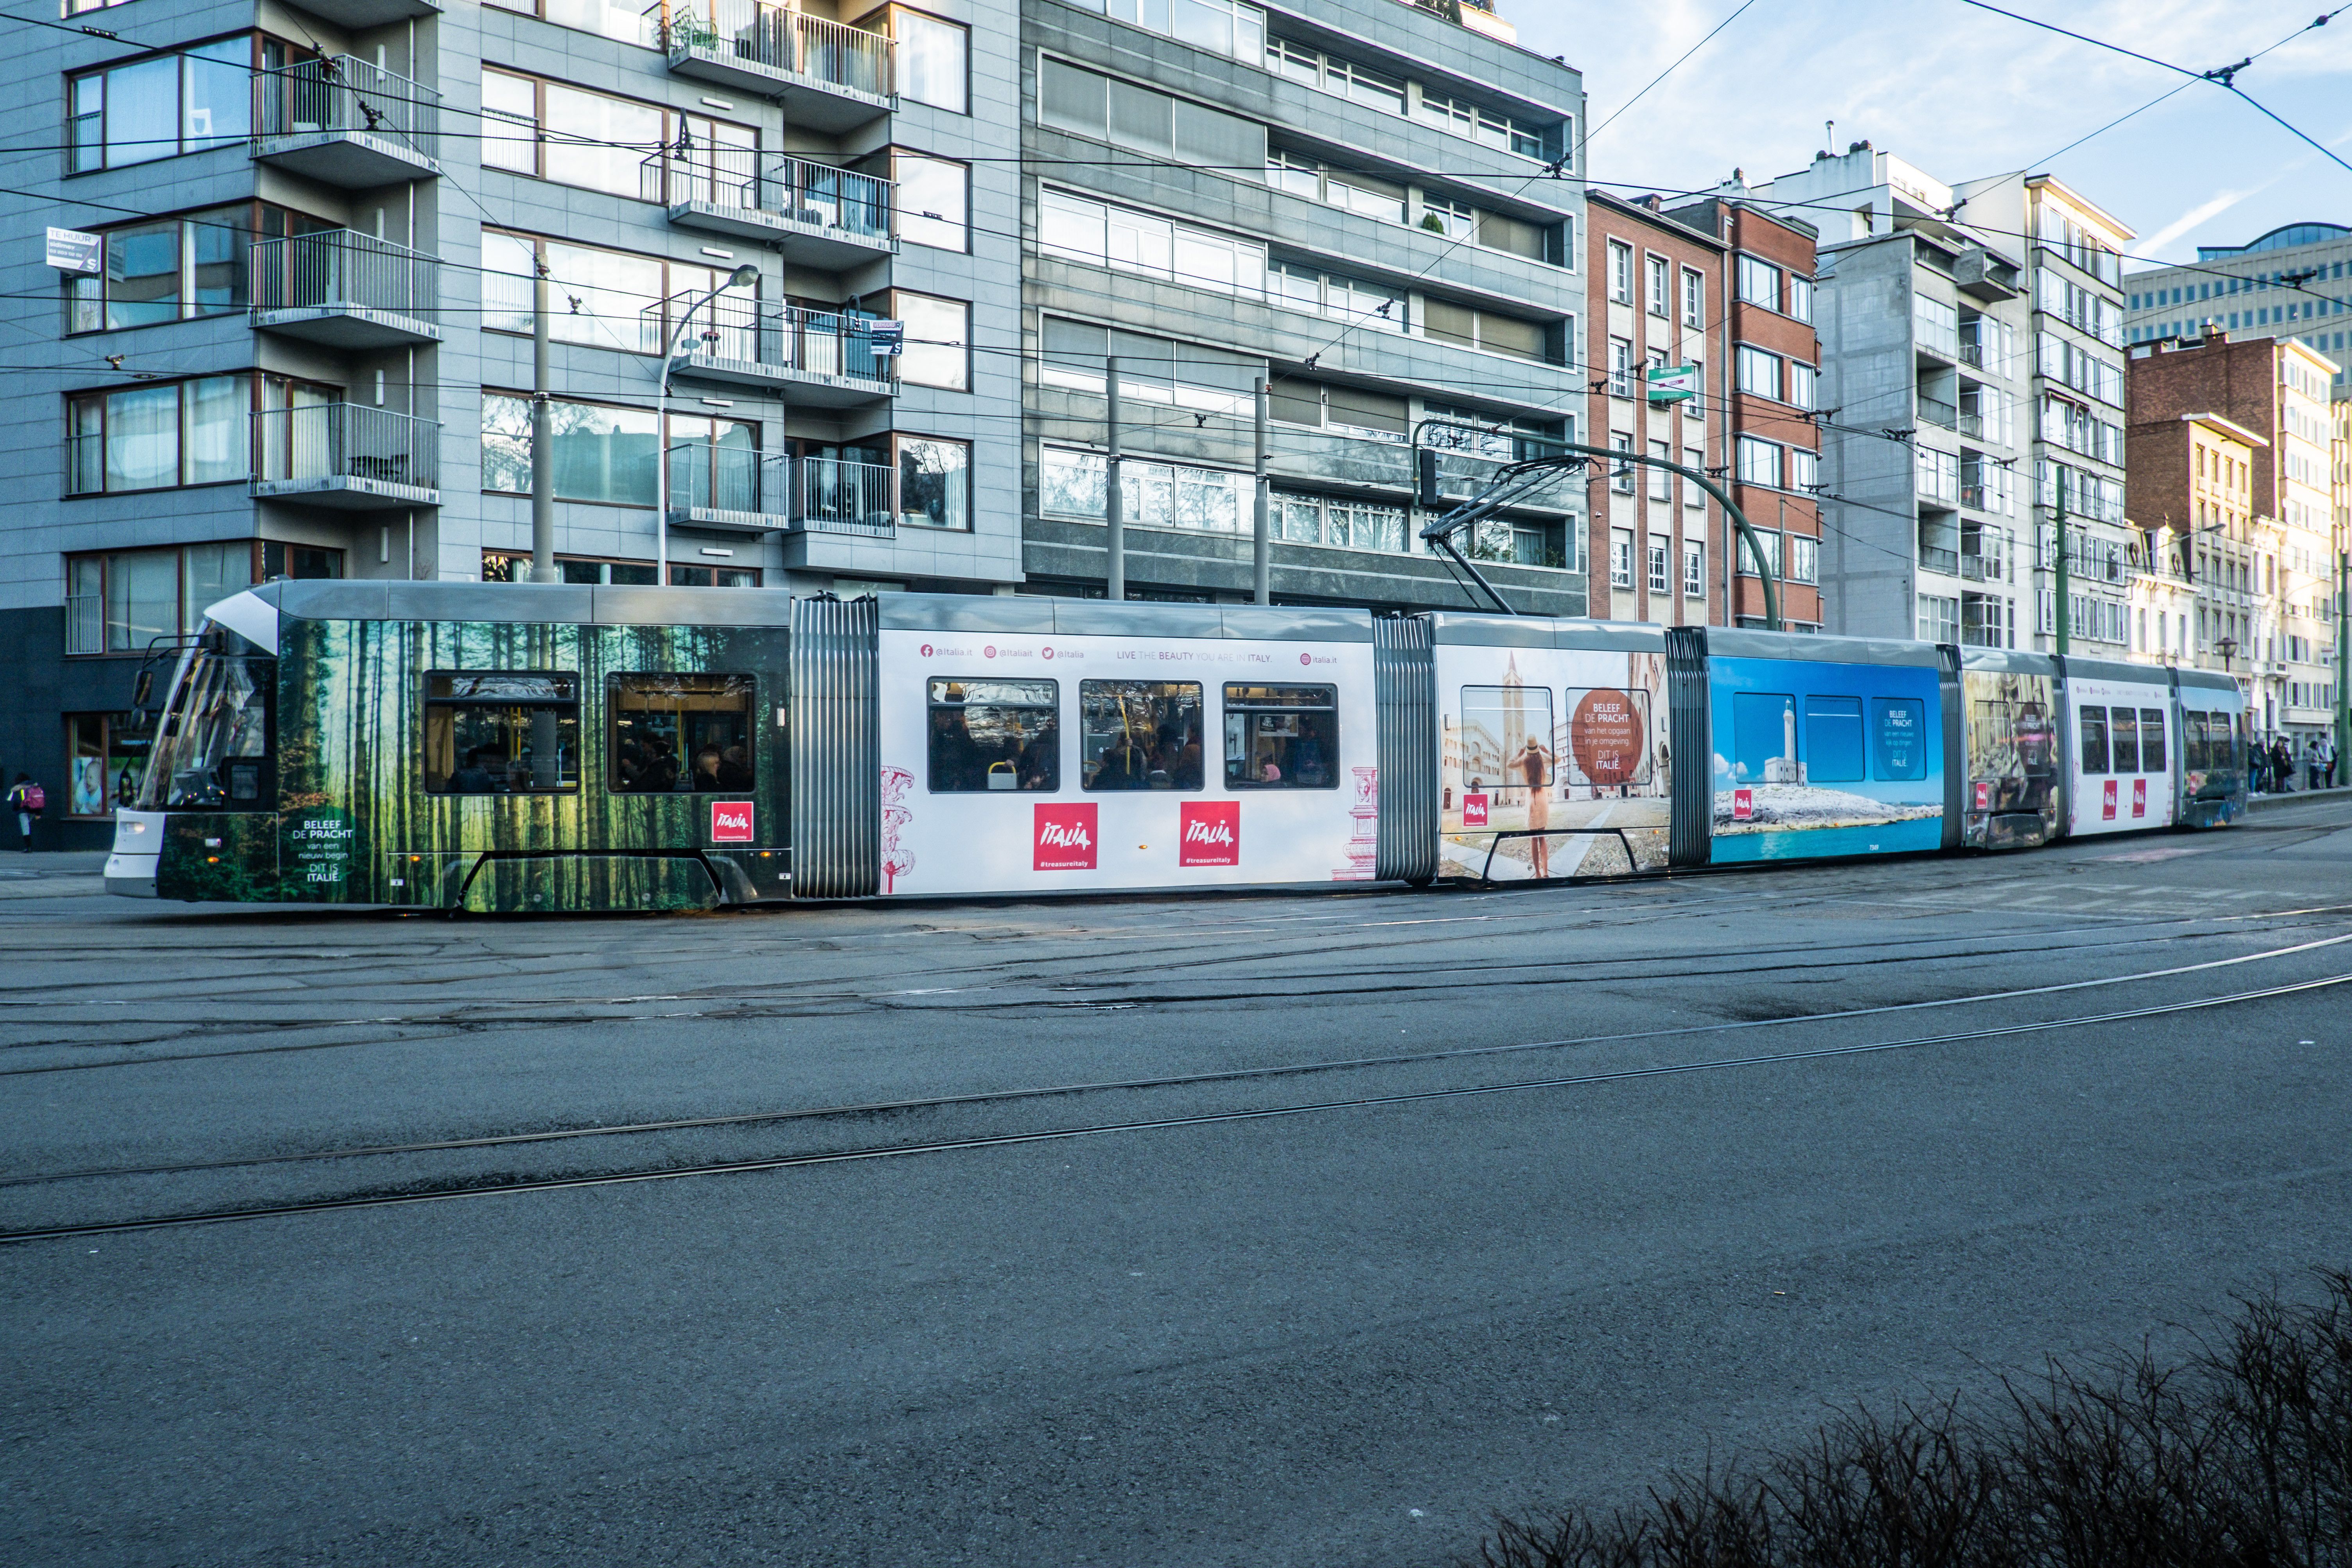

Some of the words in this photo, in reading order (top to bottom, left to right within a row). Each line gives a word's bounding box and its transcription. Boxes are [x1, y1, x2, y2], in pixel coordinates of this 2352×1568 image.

[64, 232, 91, 242] HUUR
[936, 648, 973, 656] @Italia.it
[1000, 649, 1033, 657] @Italiait
[1057, 650, 1084, 659] @Italia
[1138, 651, 1156, 659] THE
[1159, 652, 1193, 660] BEAUTY
[1196, 653, 1215, 661] YOU
[1248, 654, 1272, 663] ITALY.
[1593, 704, 1620, 712] BELEEF
[1585, 714, 1596, 722] DE
[1598, 714, 1629, 723] PRACHT
[1592, 737, 1598, 746] je
[1598, 750, 1610, 759] DIT
[1613, 750, 1619, 759] IS
[304, 820, 341, 829] BELEEF
[293, 830, 307, 839] DE
[310, 830, 353, 839] PRACHT
[325, 852, 349, 860] begin
[310, 864, 326, 872] DIT
[330, 863, 339, 872] IS
